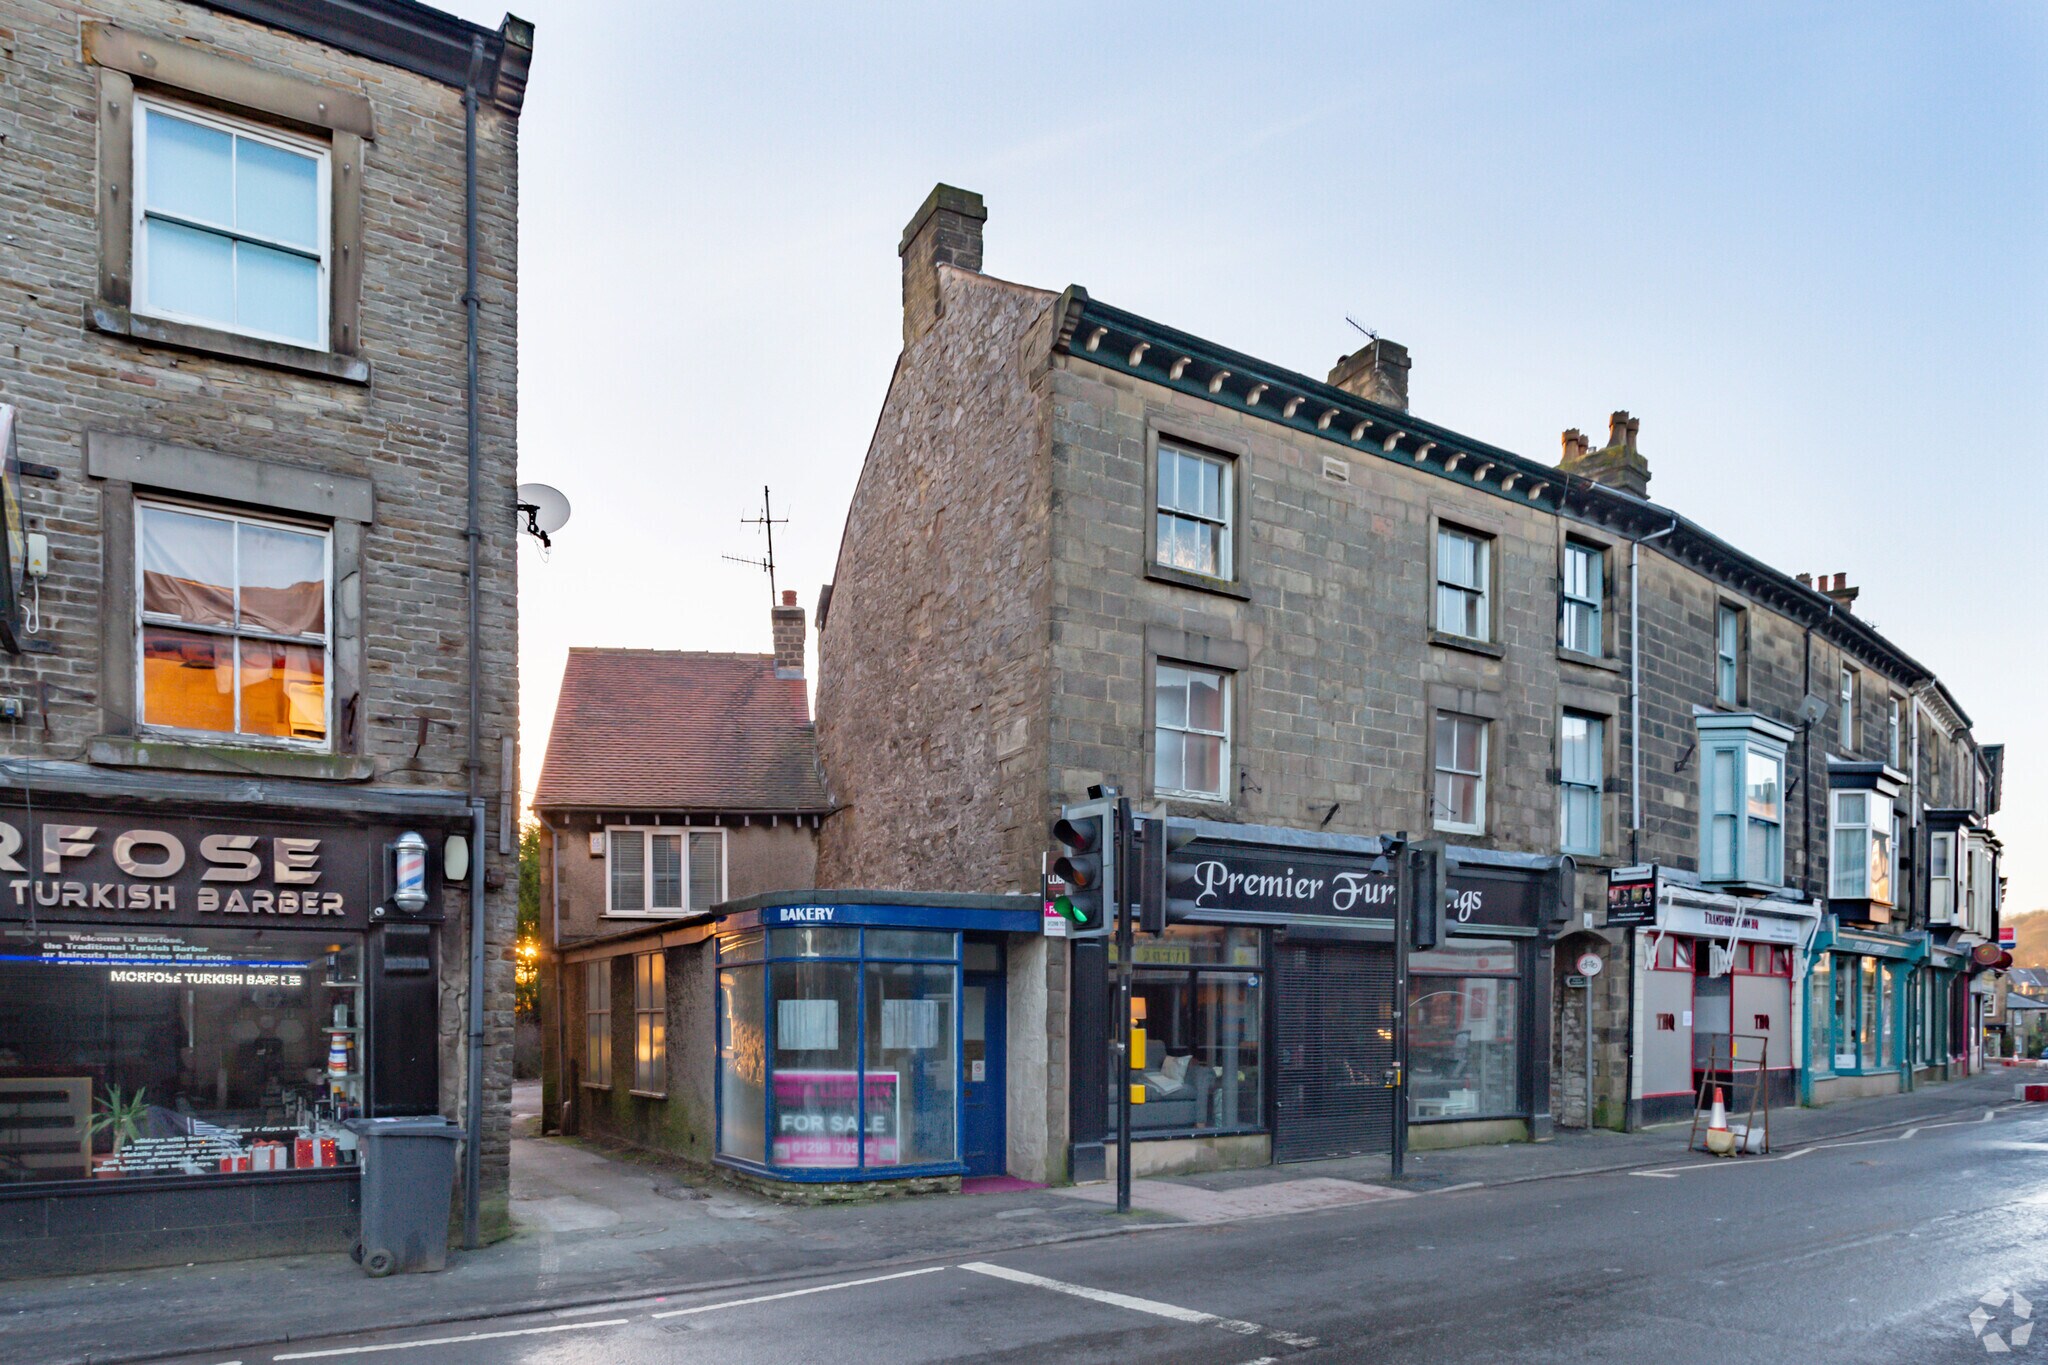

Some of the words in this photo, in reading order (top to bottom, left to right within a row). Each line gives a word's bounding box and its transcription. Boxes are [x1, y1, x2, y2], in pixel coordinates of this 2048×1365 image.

[1194, 860, 1324, 906] Premier
[9, 879, 176, 911] TURKISH
[197, 887, 346, 916] BARBER
[780, 907, 835, 922] BAKERY
[69, 934, 120, 943] Welcome
[123, 935, 134, 943] to
[43, 942, 62, 950] the
[65, 942, 126, 951] Traditional
[128, 944, 170, 952] Turkish
[172, 945, 209, 953] Barber
[58, 951, 105, 959] haircuts
[175, 953, 193, 961] full
[196, 953, 232, 961] service
[110, 970, 182, 984] MORFOSE
[184, 972, 243, 985] TURKISH
[780, 1115, 825, 1131] FOR
[830, 1115, 886, 1132] SALE
